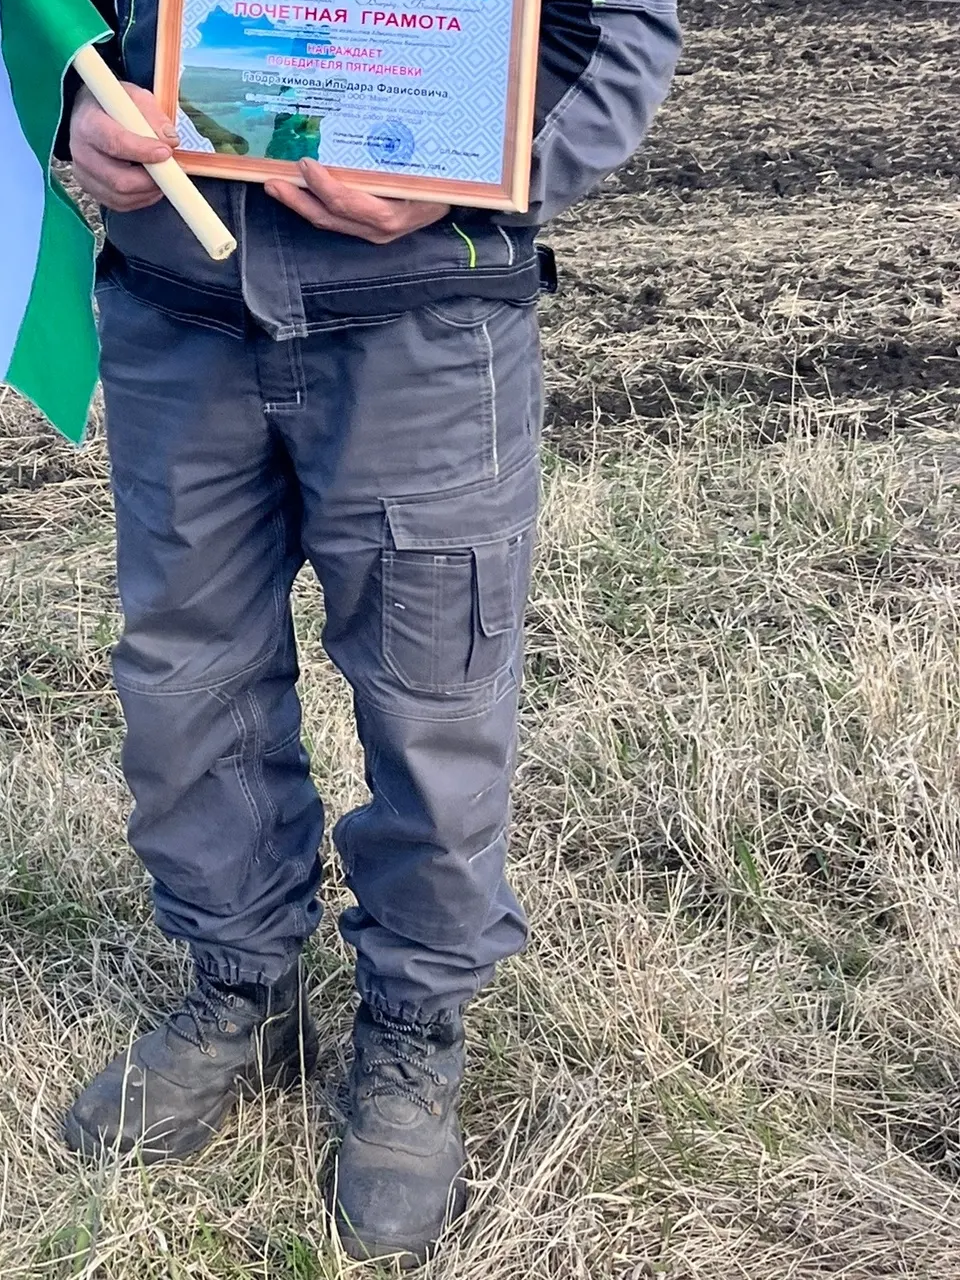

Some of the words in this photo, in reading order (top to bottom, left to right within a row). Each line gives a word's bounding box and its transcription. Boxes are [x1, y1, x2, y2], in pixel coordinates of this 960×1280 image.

[234, 2, 347, 22] ПОЧЕТНАЯ
[361, 10, 461, 31] ГРАМОТА
[307, 44, 382, 58] НАГРАЖДАЕТ
[268, 55, 343, 70] ПОБЕДИТЕЛЯ
[346, 61, 422, 77] ПЯТИДНЕВКИ
[325, 79, 374, 93] Ильдара
[377, 83, 448, 98] Фависовича
